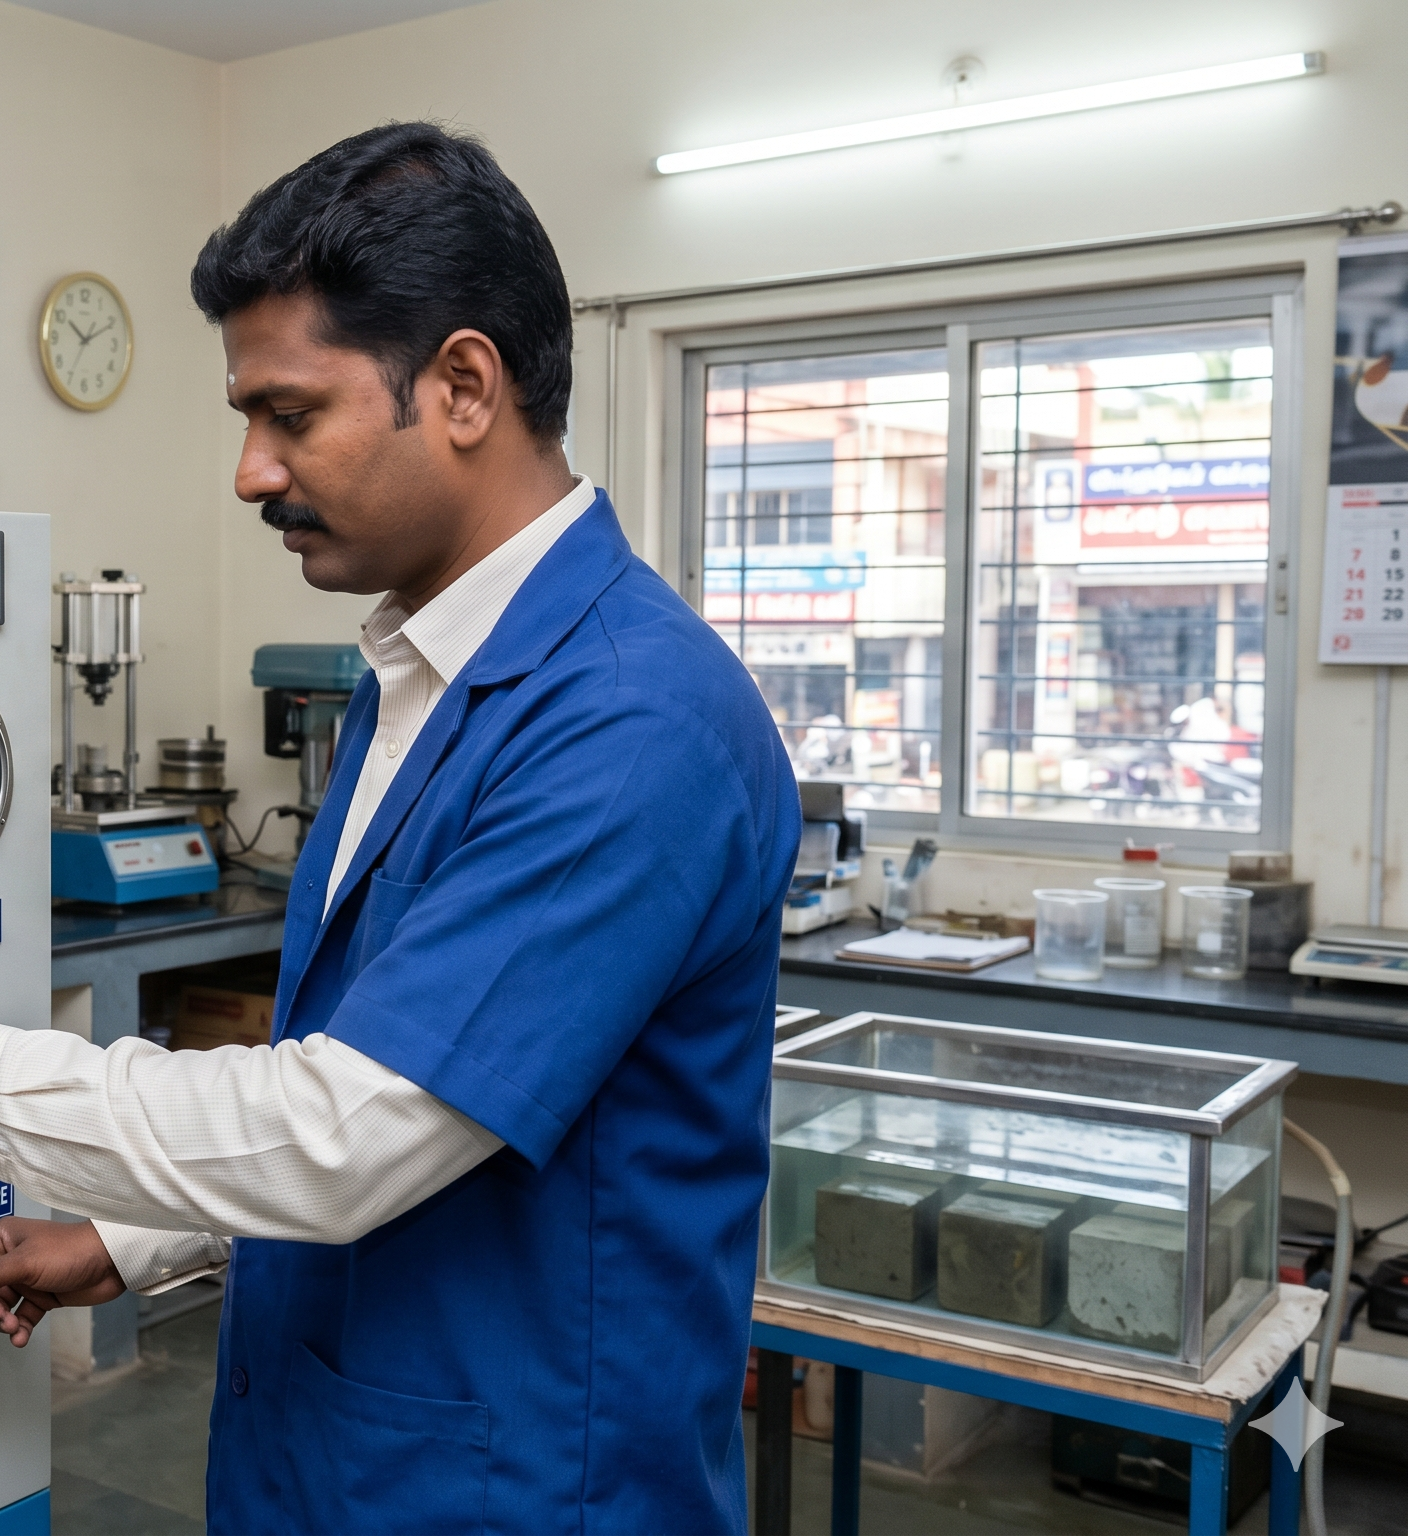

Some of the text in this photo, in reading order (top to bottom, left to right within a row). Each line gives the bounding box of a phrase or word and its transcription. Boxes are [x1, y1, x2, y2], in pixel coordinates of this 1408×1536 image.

[1352, 548, 1361, 562] 7
[1347, 568, 1404, 581] 14 15
[1345, 588, 1404, 601] 21 22
[1381, 608, 1404, 621] 29
